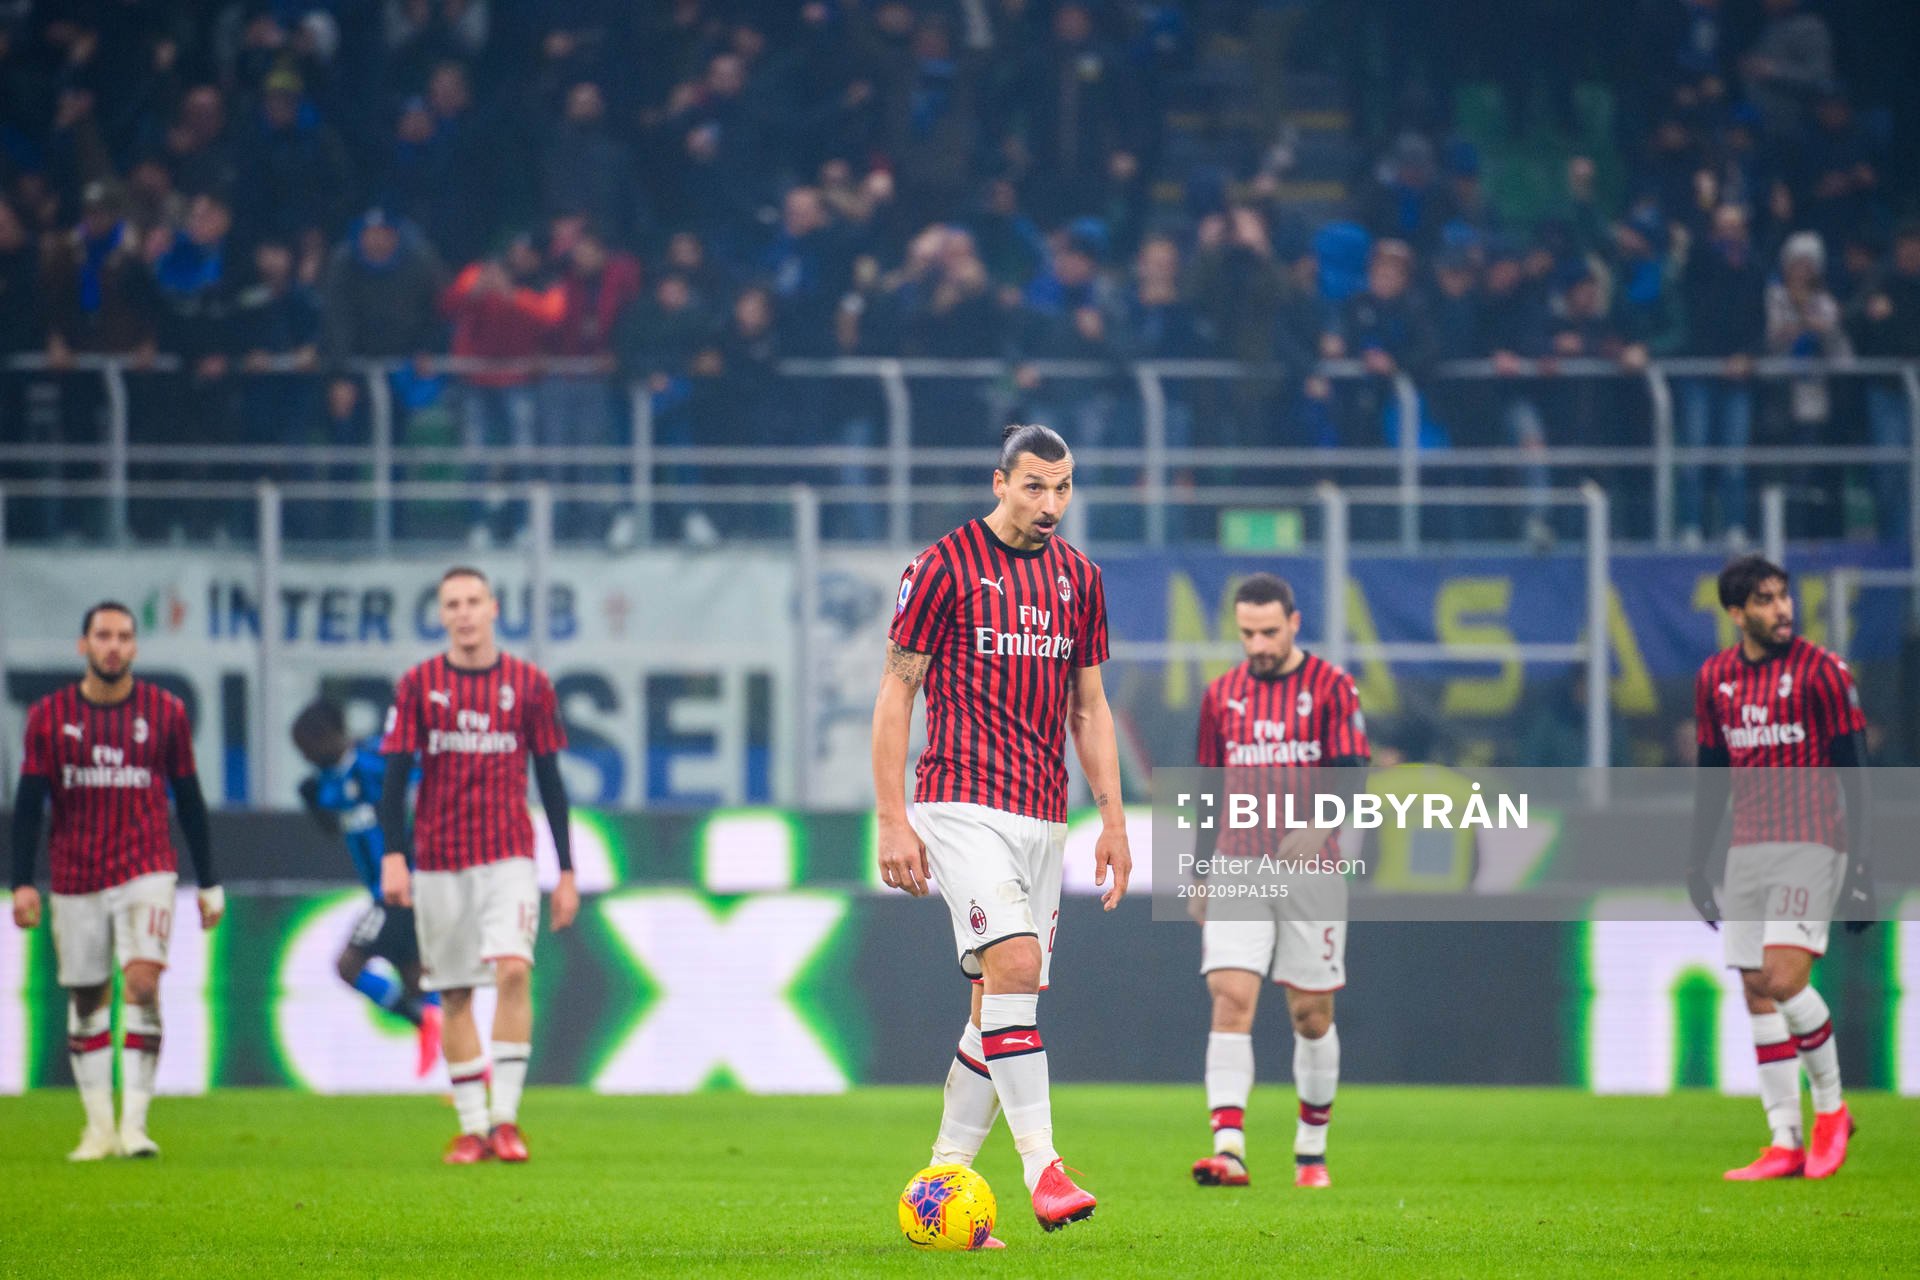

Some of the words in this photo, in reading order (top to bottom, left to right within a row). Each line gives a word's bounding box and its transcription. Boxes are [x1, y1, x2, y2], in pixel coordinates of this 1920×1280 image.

[208, 577, 394, 643] INTER
[413, 578, 580, 643] CUB
[1019, 605, 1051, 631] Fly
[975, 627, 1075, 660] Emirates
[1775, 884, 1809, 918] 39
[147, 904, 172, 940] 10
[1322, 926, 1335, 961] 5
